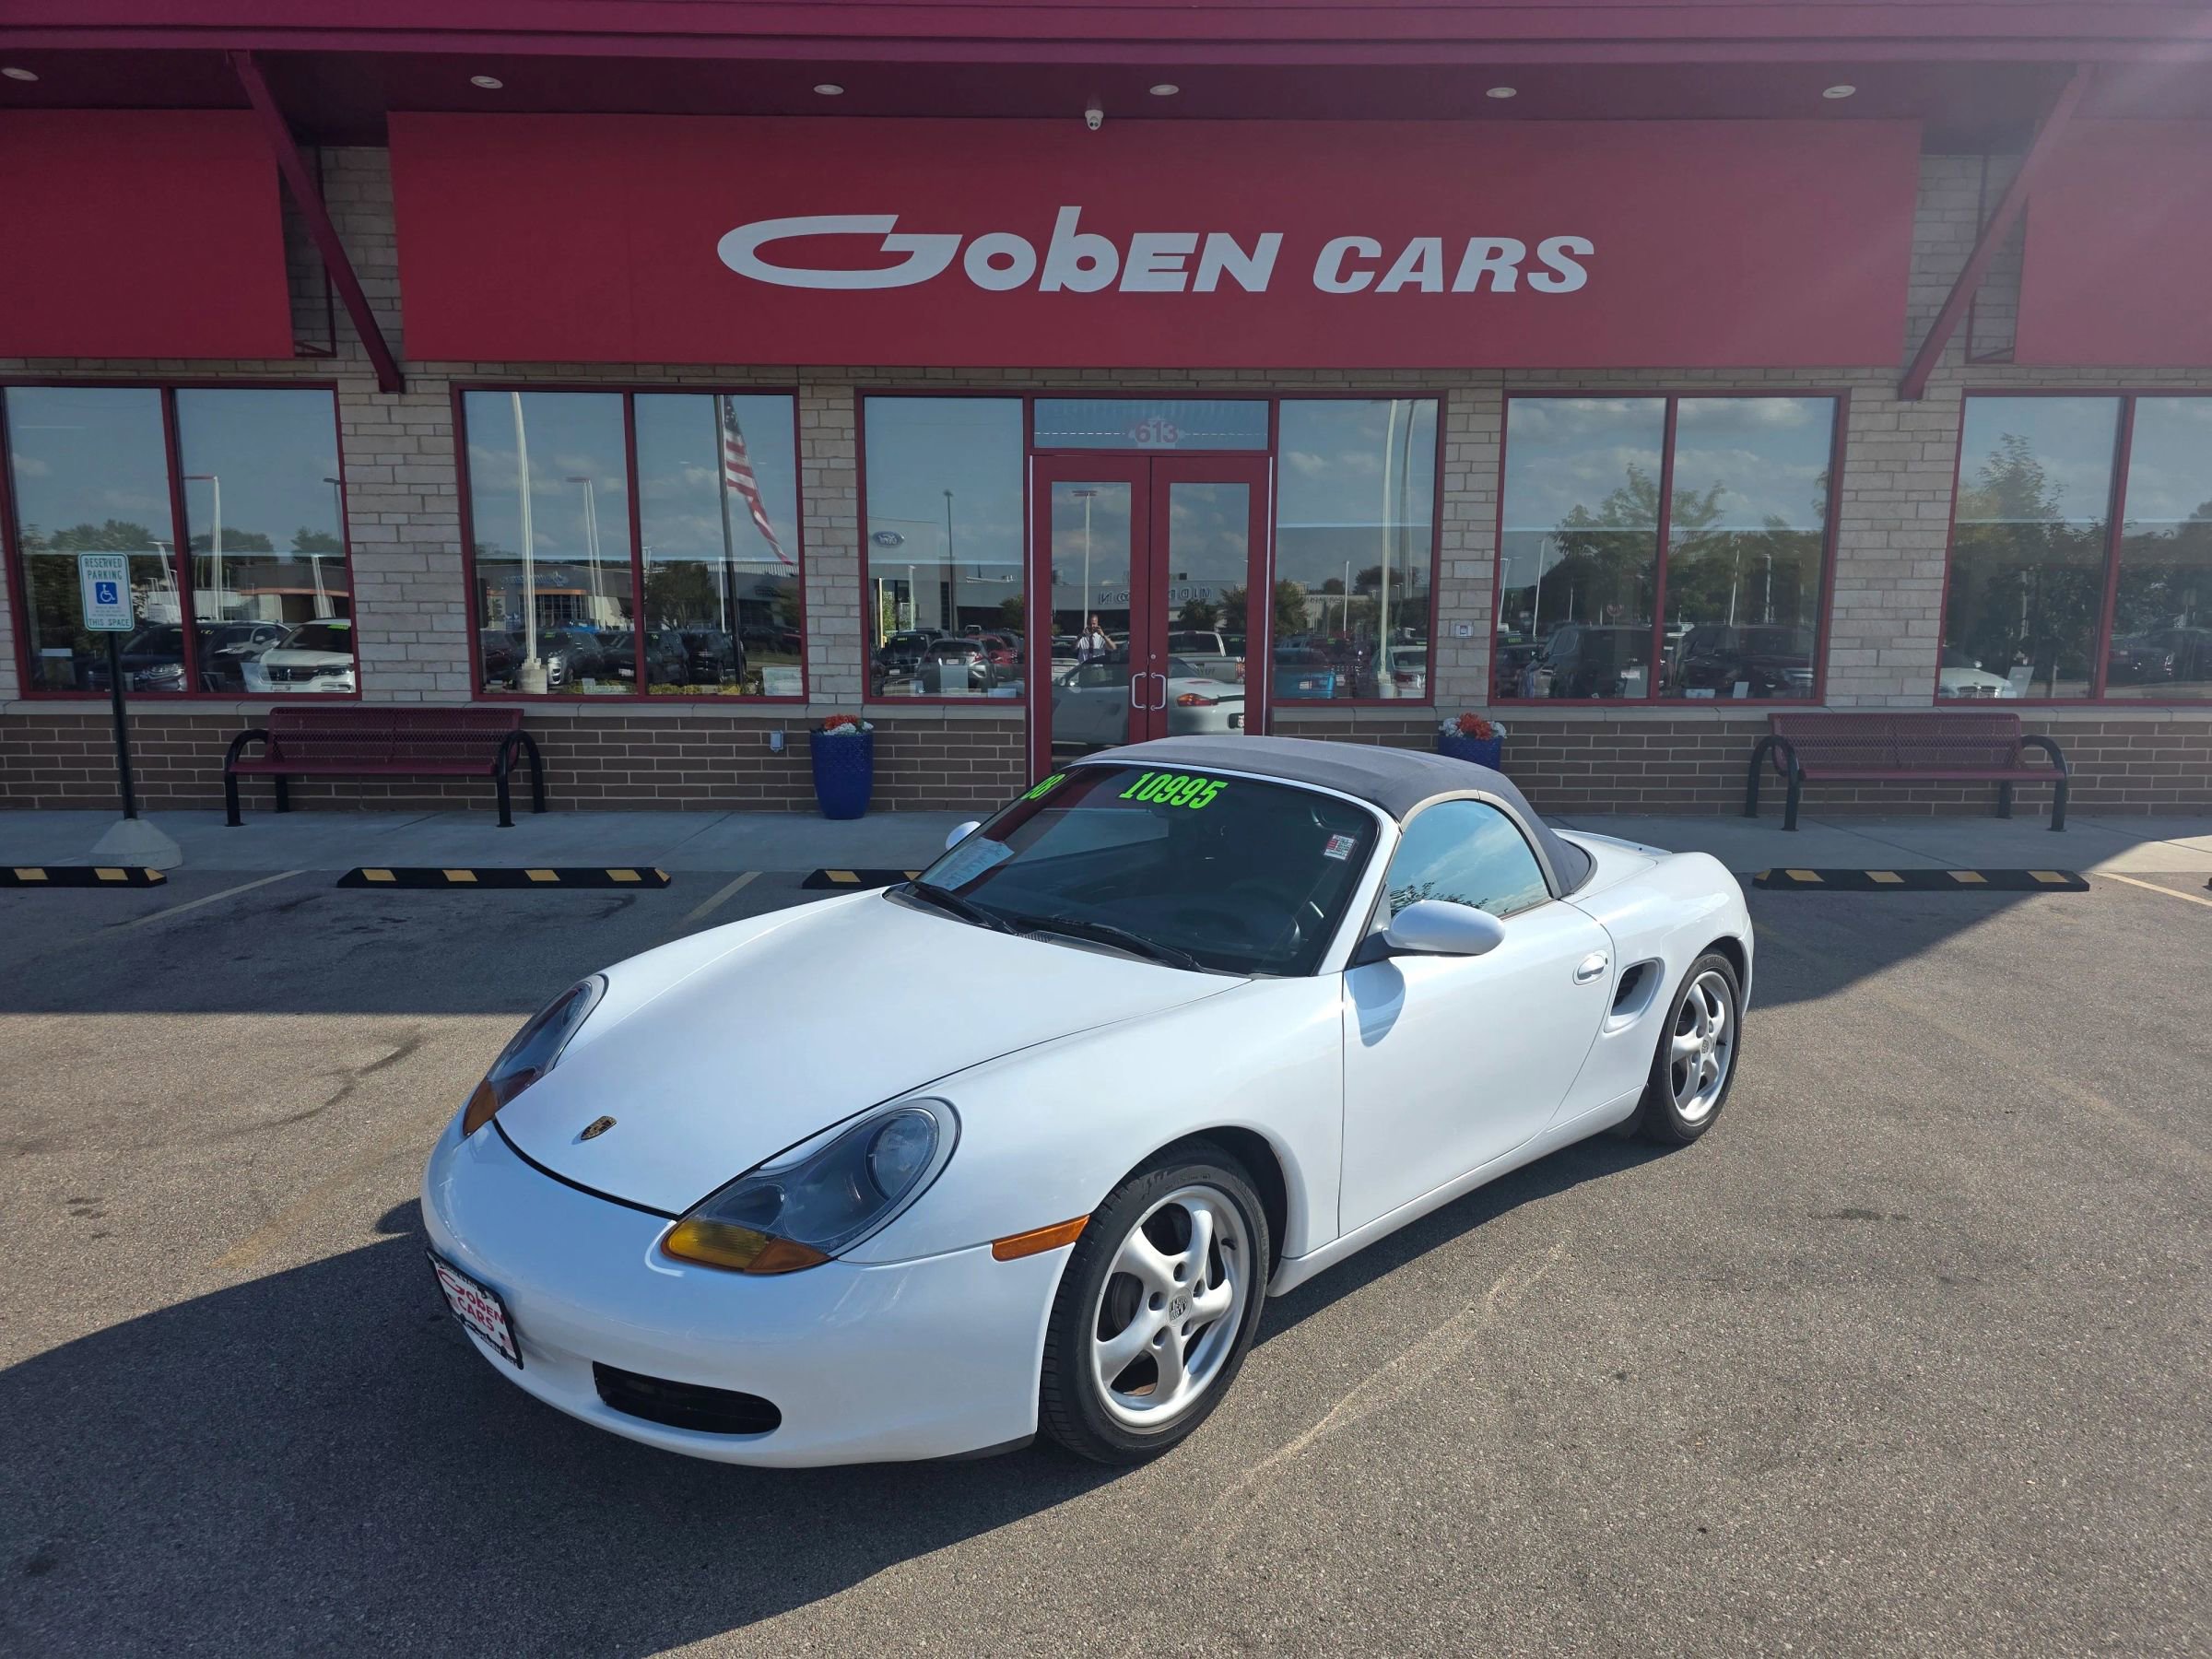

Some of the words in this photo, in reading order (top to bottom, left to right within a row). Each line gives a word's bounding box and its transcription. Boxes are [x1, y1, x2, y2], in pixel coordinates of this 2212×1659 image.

[1312, 235, 1594, 294] CARS
[1135, 419, 1179, 443] 613
[84, 558, 123, 569] RESERVED
[88, 570, 123, 581] PARKING
[88, 618, 105, 627] THIS
[108, 618, 131, 627] SPACE
[1118, 771, 1229, 809] 10995
[457, 1296, 496, 1333] CARS
